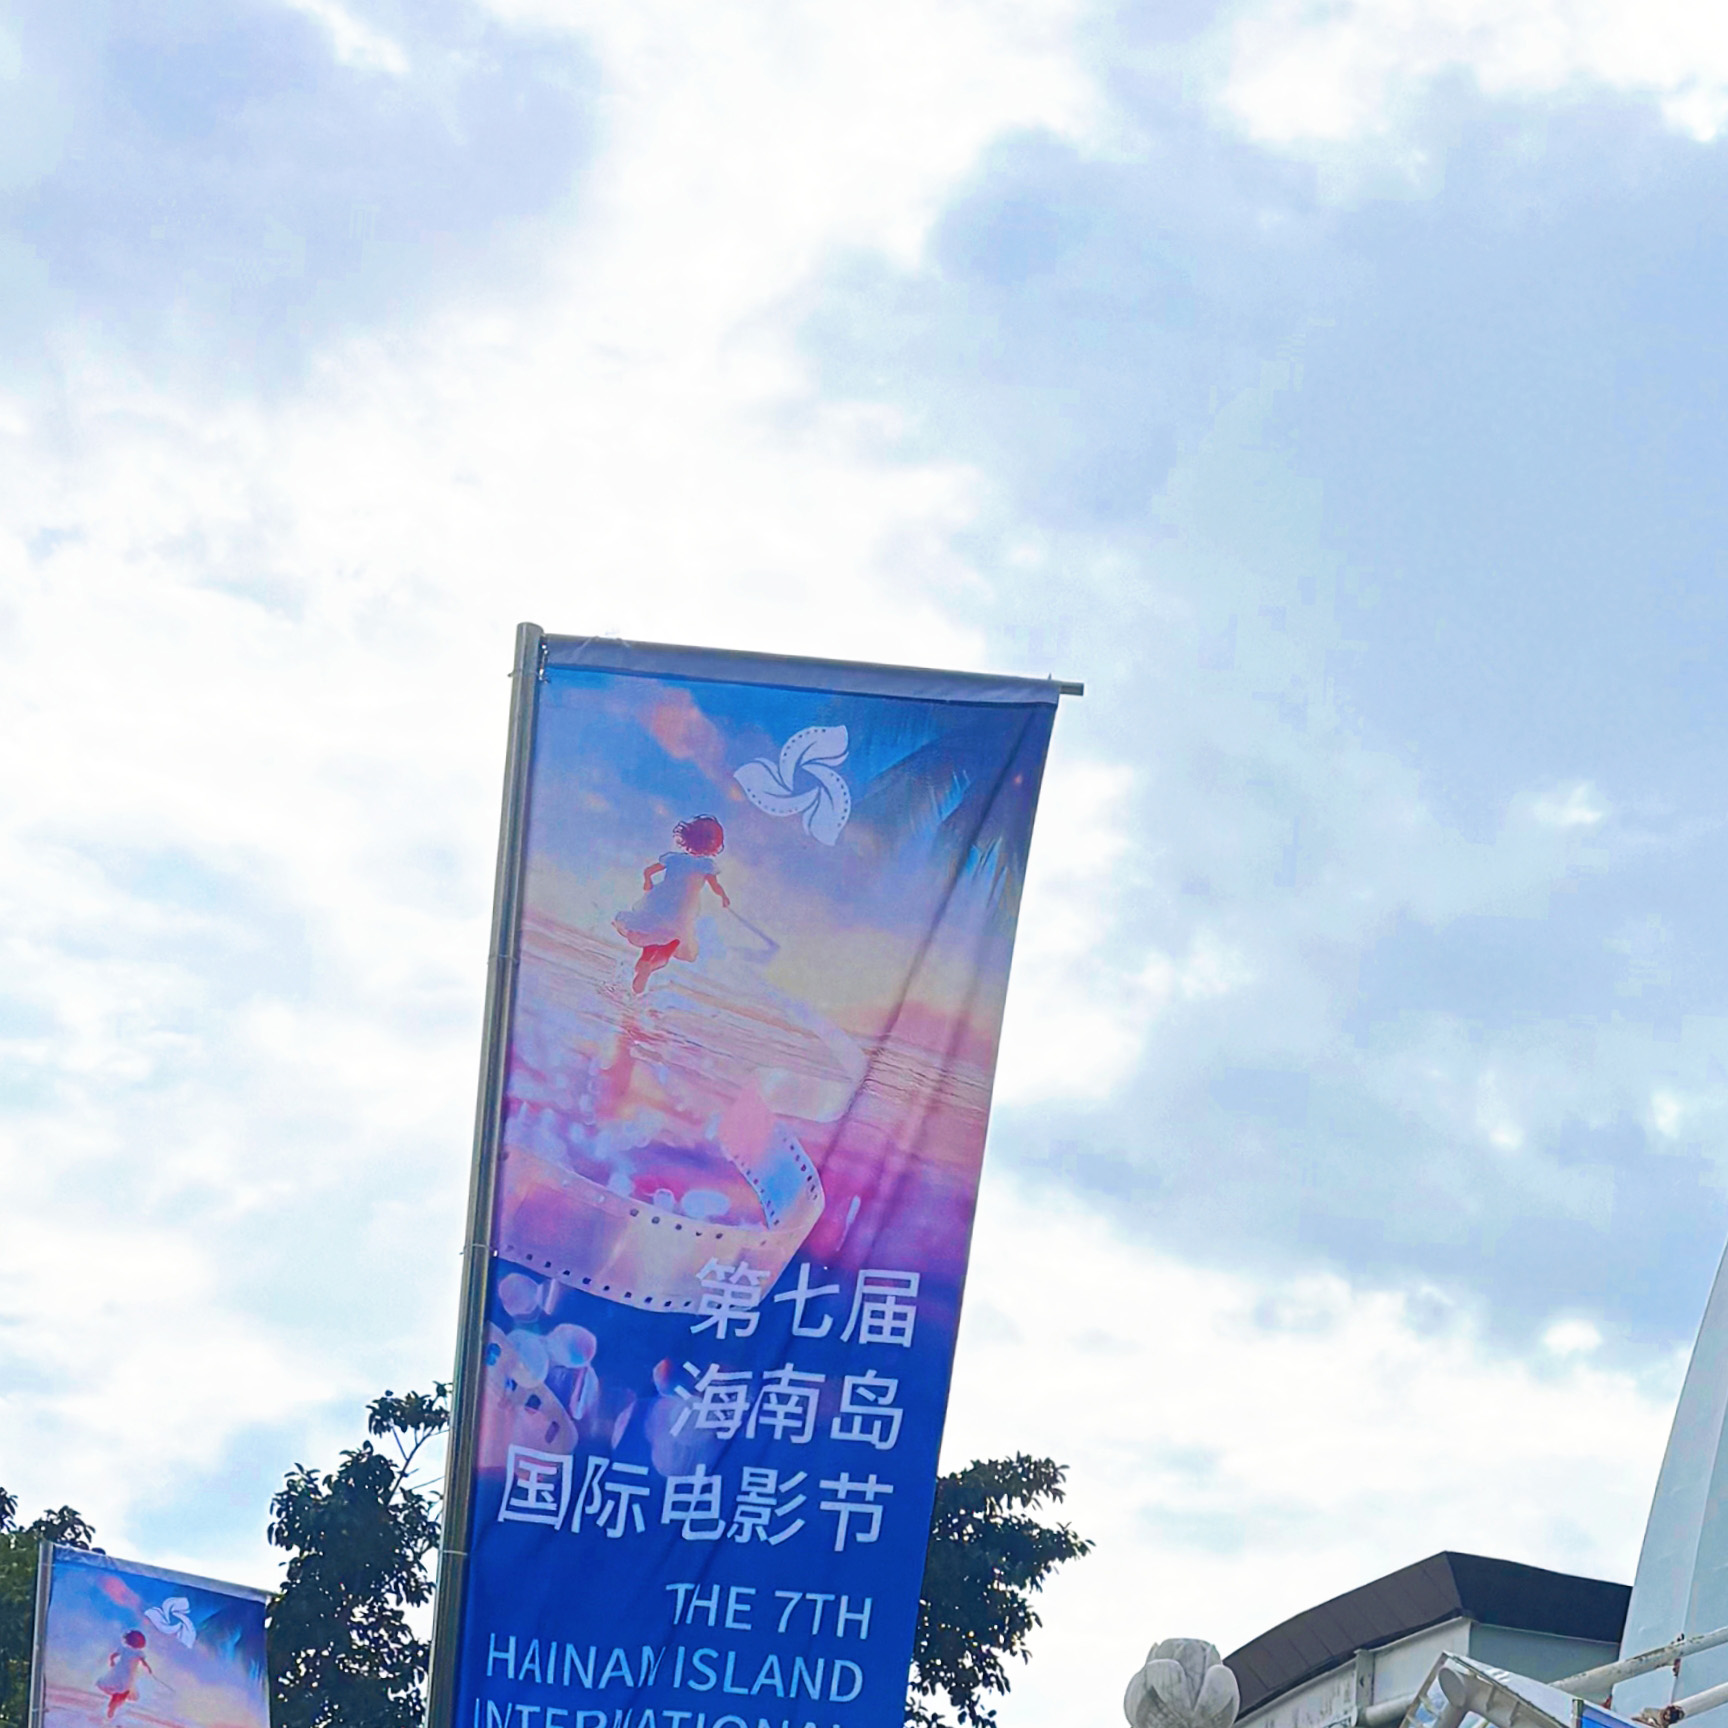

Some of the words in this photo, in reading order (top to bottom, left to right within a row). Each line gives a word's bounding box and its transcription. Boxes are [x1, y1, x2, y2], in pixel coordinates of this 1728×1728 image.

[690, 1257, 921, 1348] 第七届
[669, 1361, 904, 1451] 海南岛
[497, 1444, 893, 1552] 国际电影节
[666, 1583, 756, 1630] THE
[775, 1590, 872, 1640] 7TH
[487, 1633, 666, 1689] HAINAN
[673, 1646, 863, 1703] ISLAND
